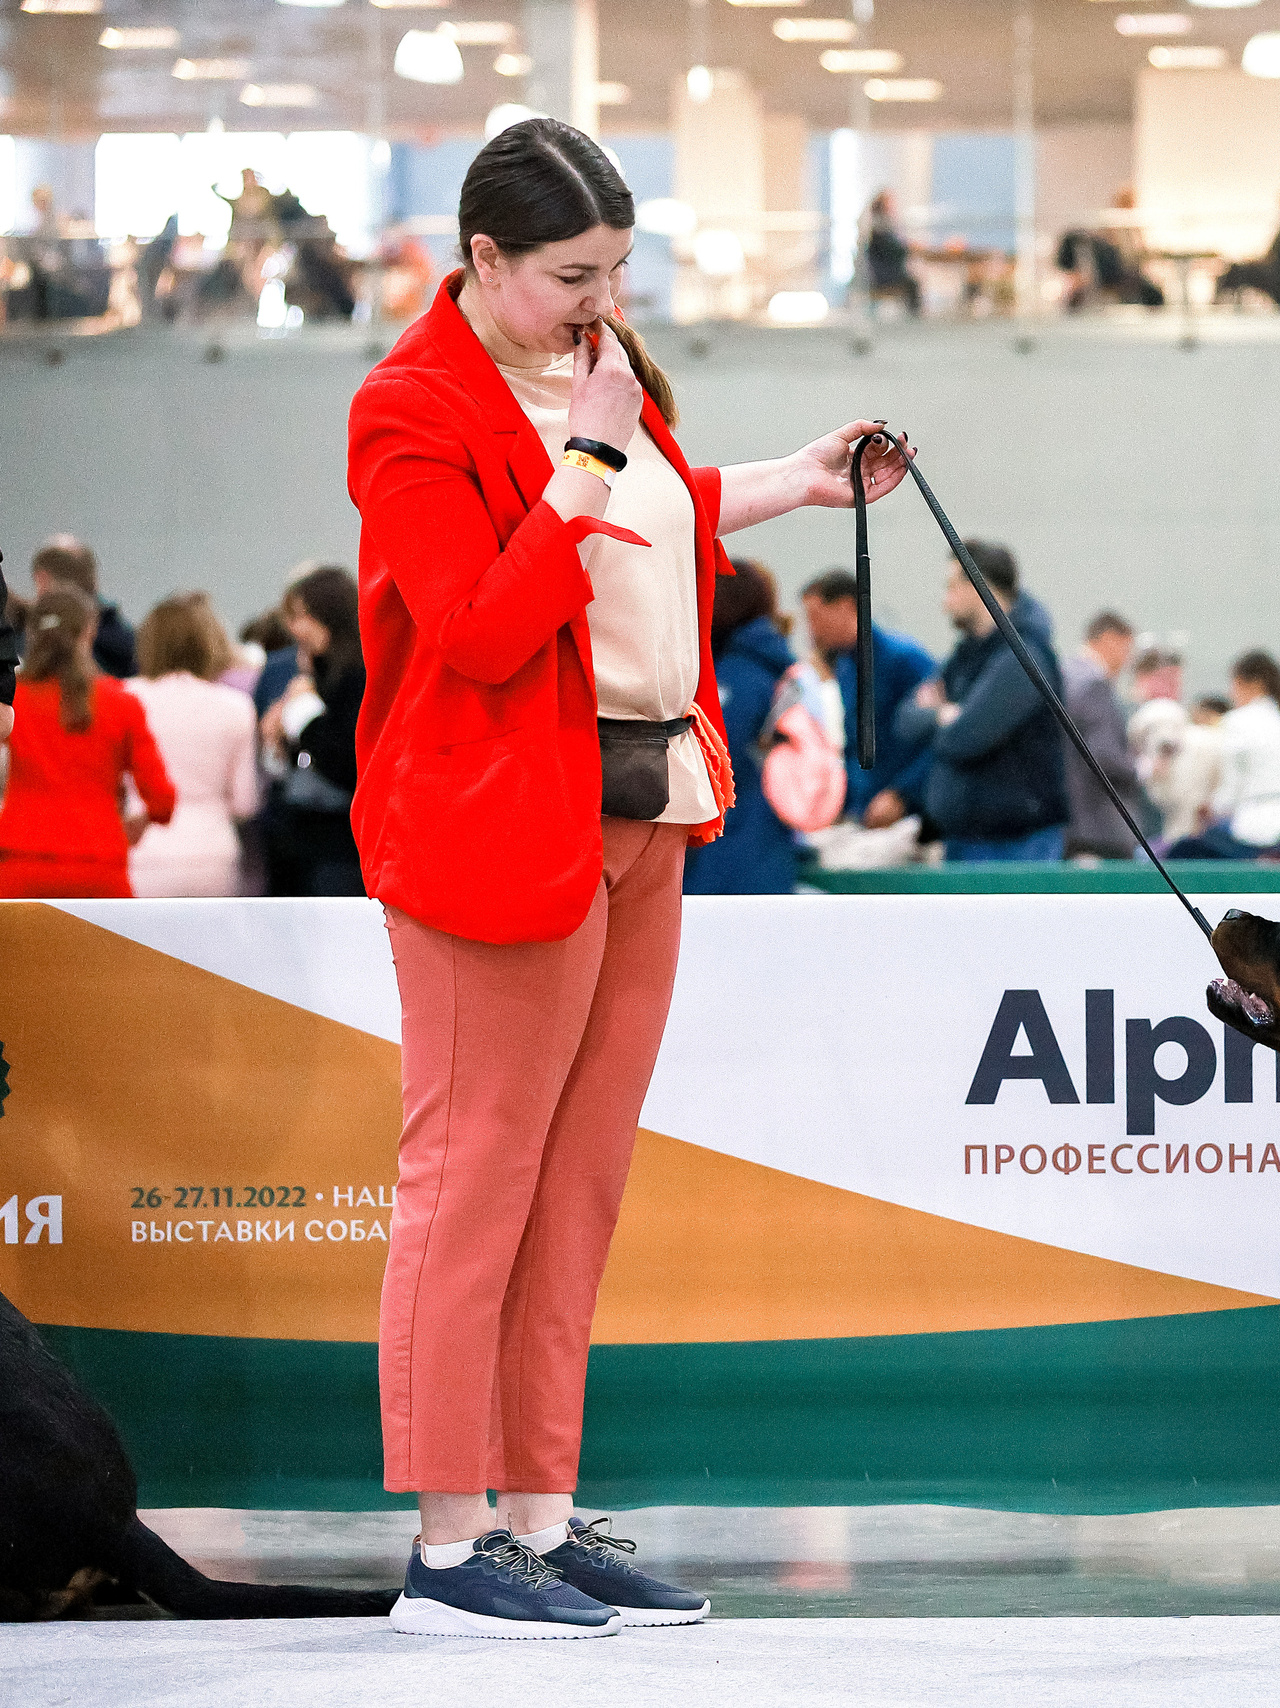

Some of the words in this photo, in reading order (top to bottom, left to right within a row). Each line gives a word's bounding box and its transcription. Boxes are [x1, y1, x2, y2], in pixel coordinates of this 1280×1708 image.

[131, 1186, 307, 1208] 26-27.11.2022
[131, 1219, 295, 1242] ВЫСТАВКИ
[304, 1219, 393, 1242] СОБА
